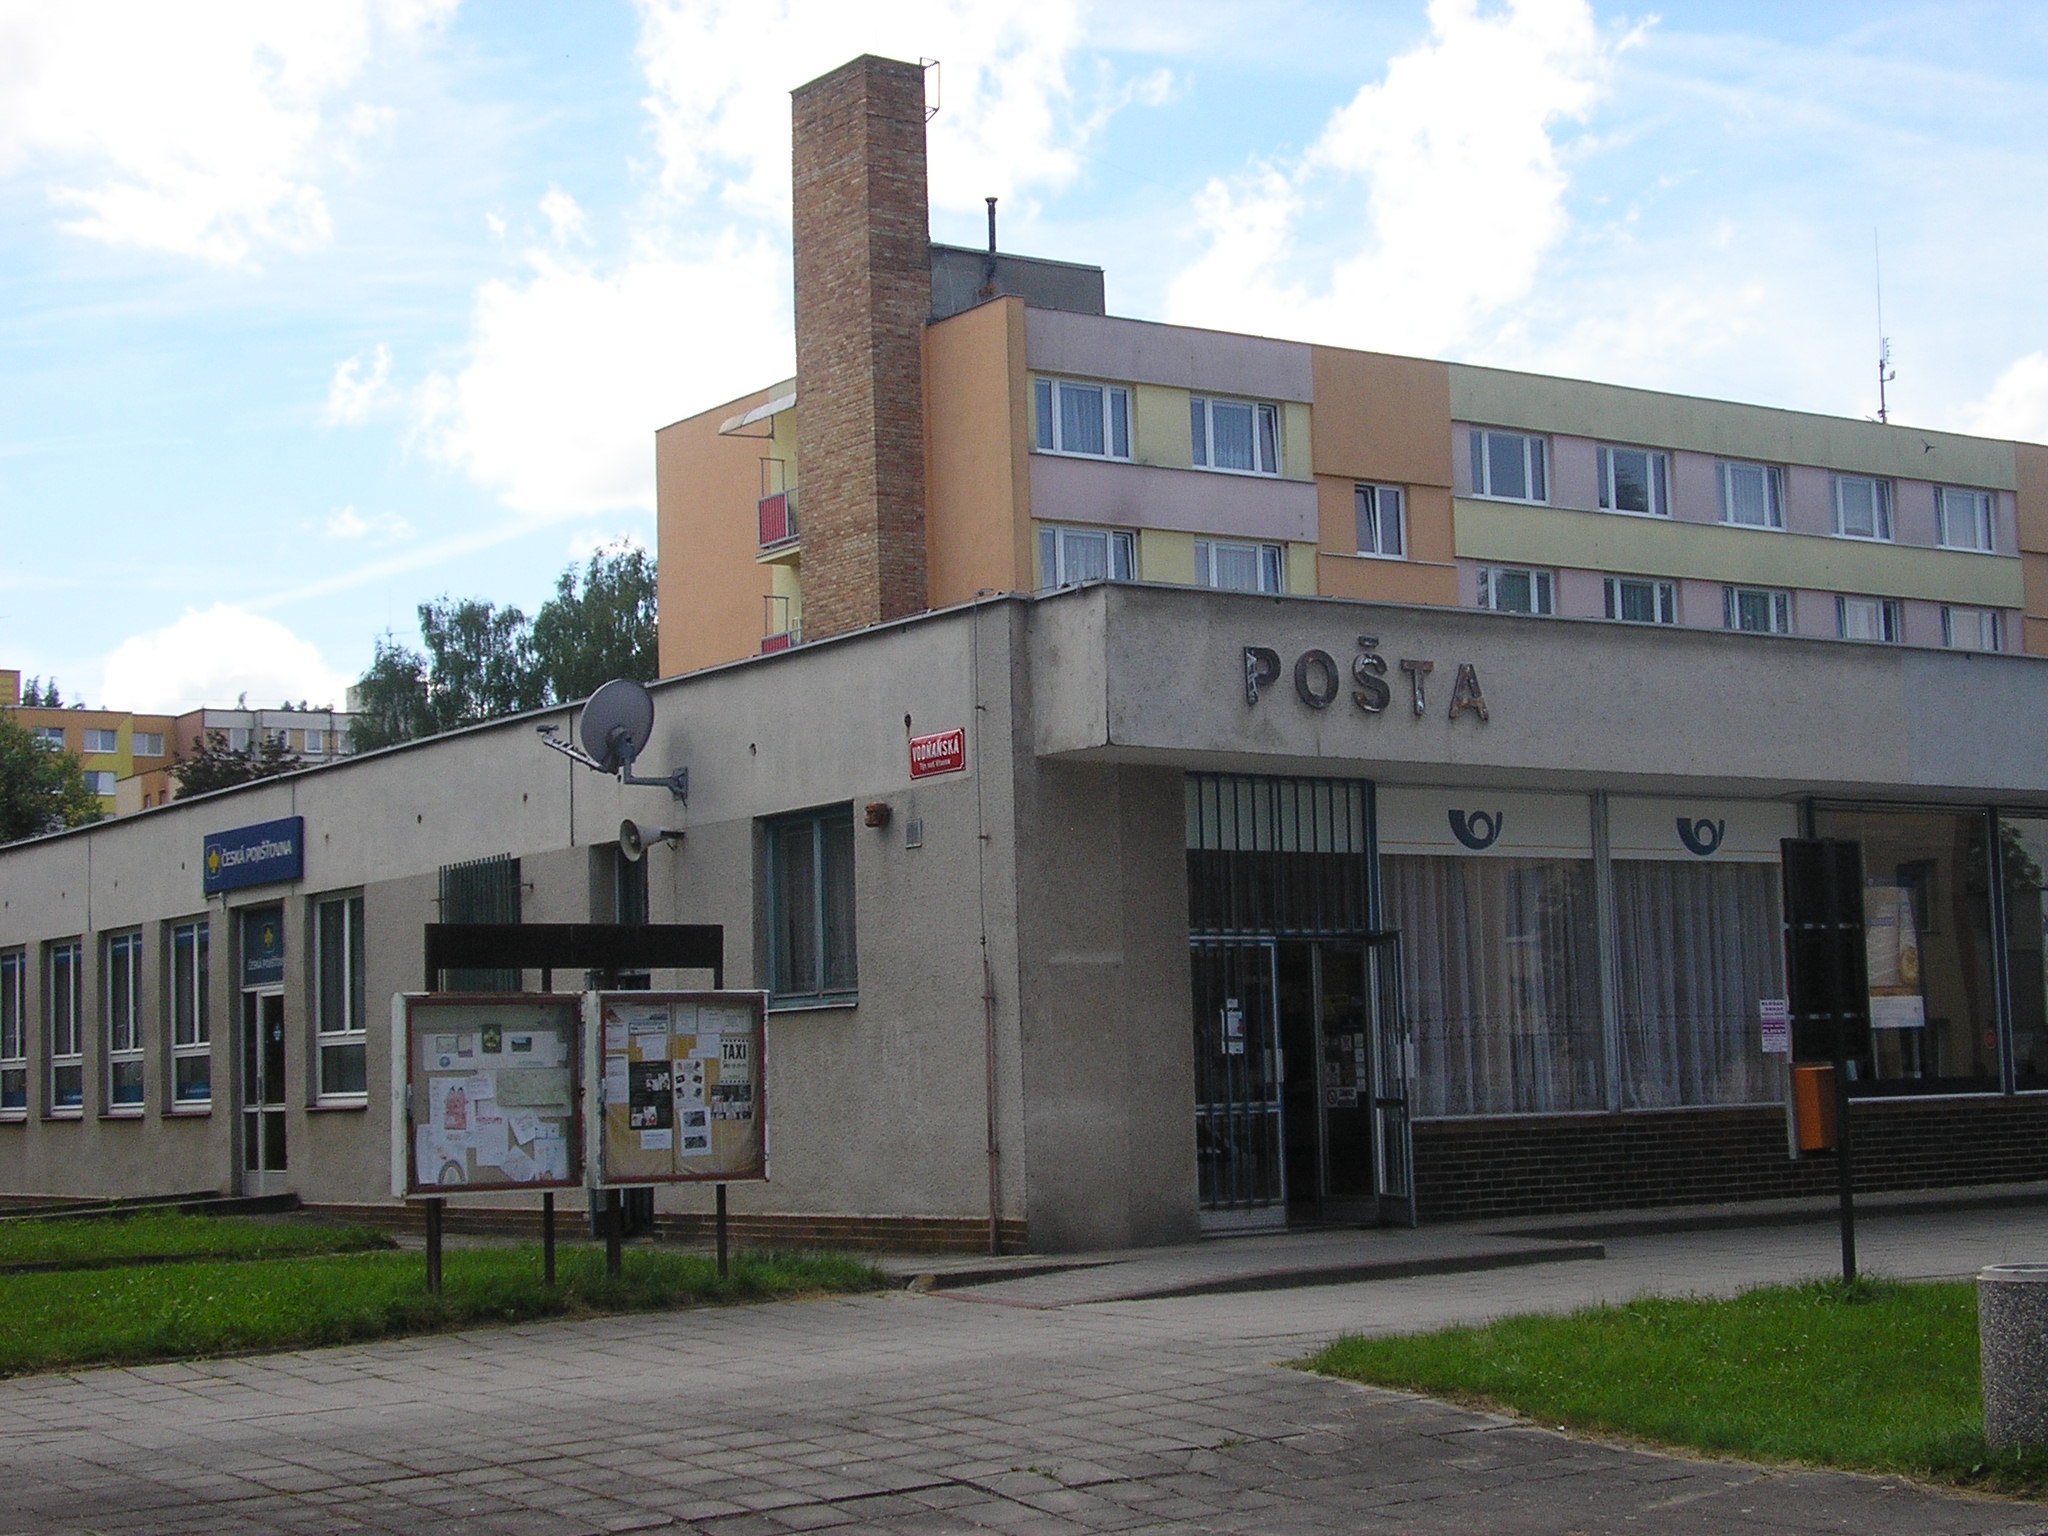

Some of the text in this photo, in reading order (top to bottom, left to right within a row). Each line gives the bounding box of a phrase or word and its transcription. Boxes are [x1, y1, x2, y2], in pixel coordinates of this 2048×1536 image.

[1243, 635, 1489, 721] POŠTA
[221, 840, 292, 867] ČESKÁ POJIŠŤOVNA
[722, 1044, 746, 1060] TAXI
